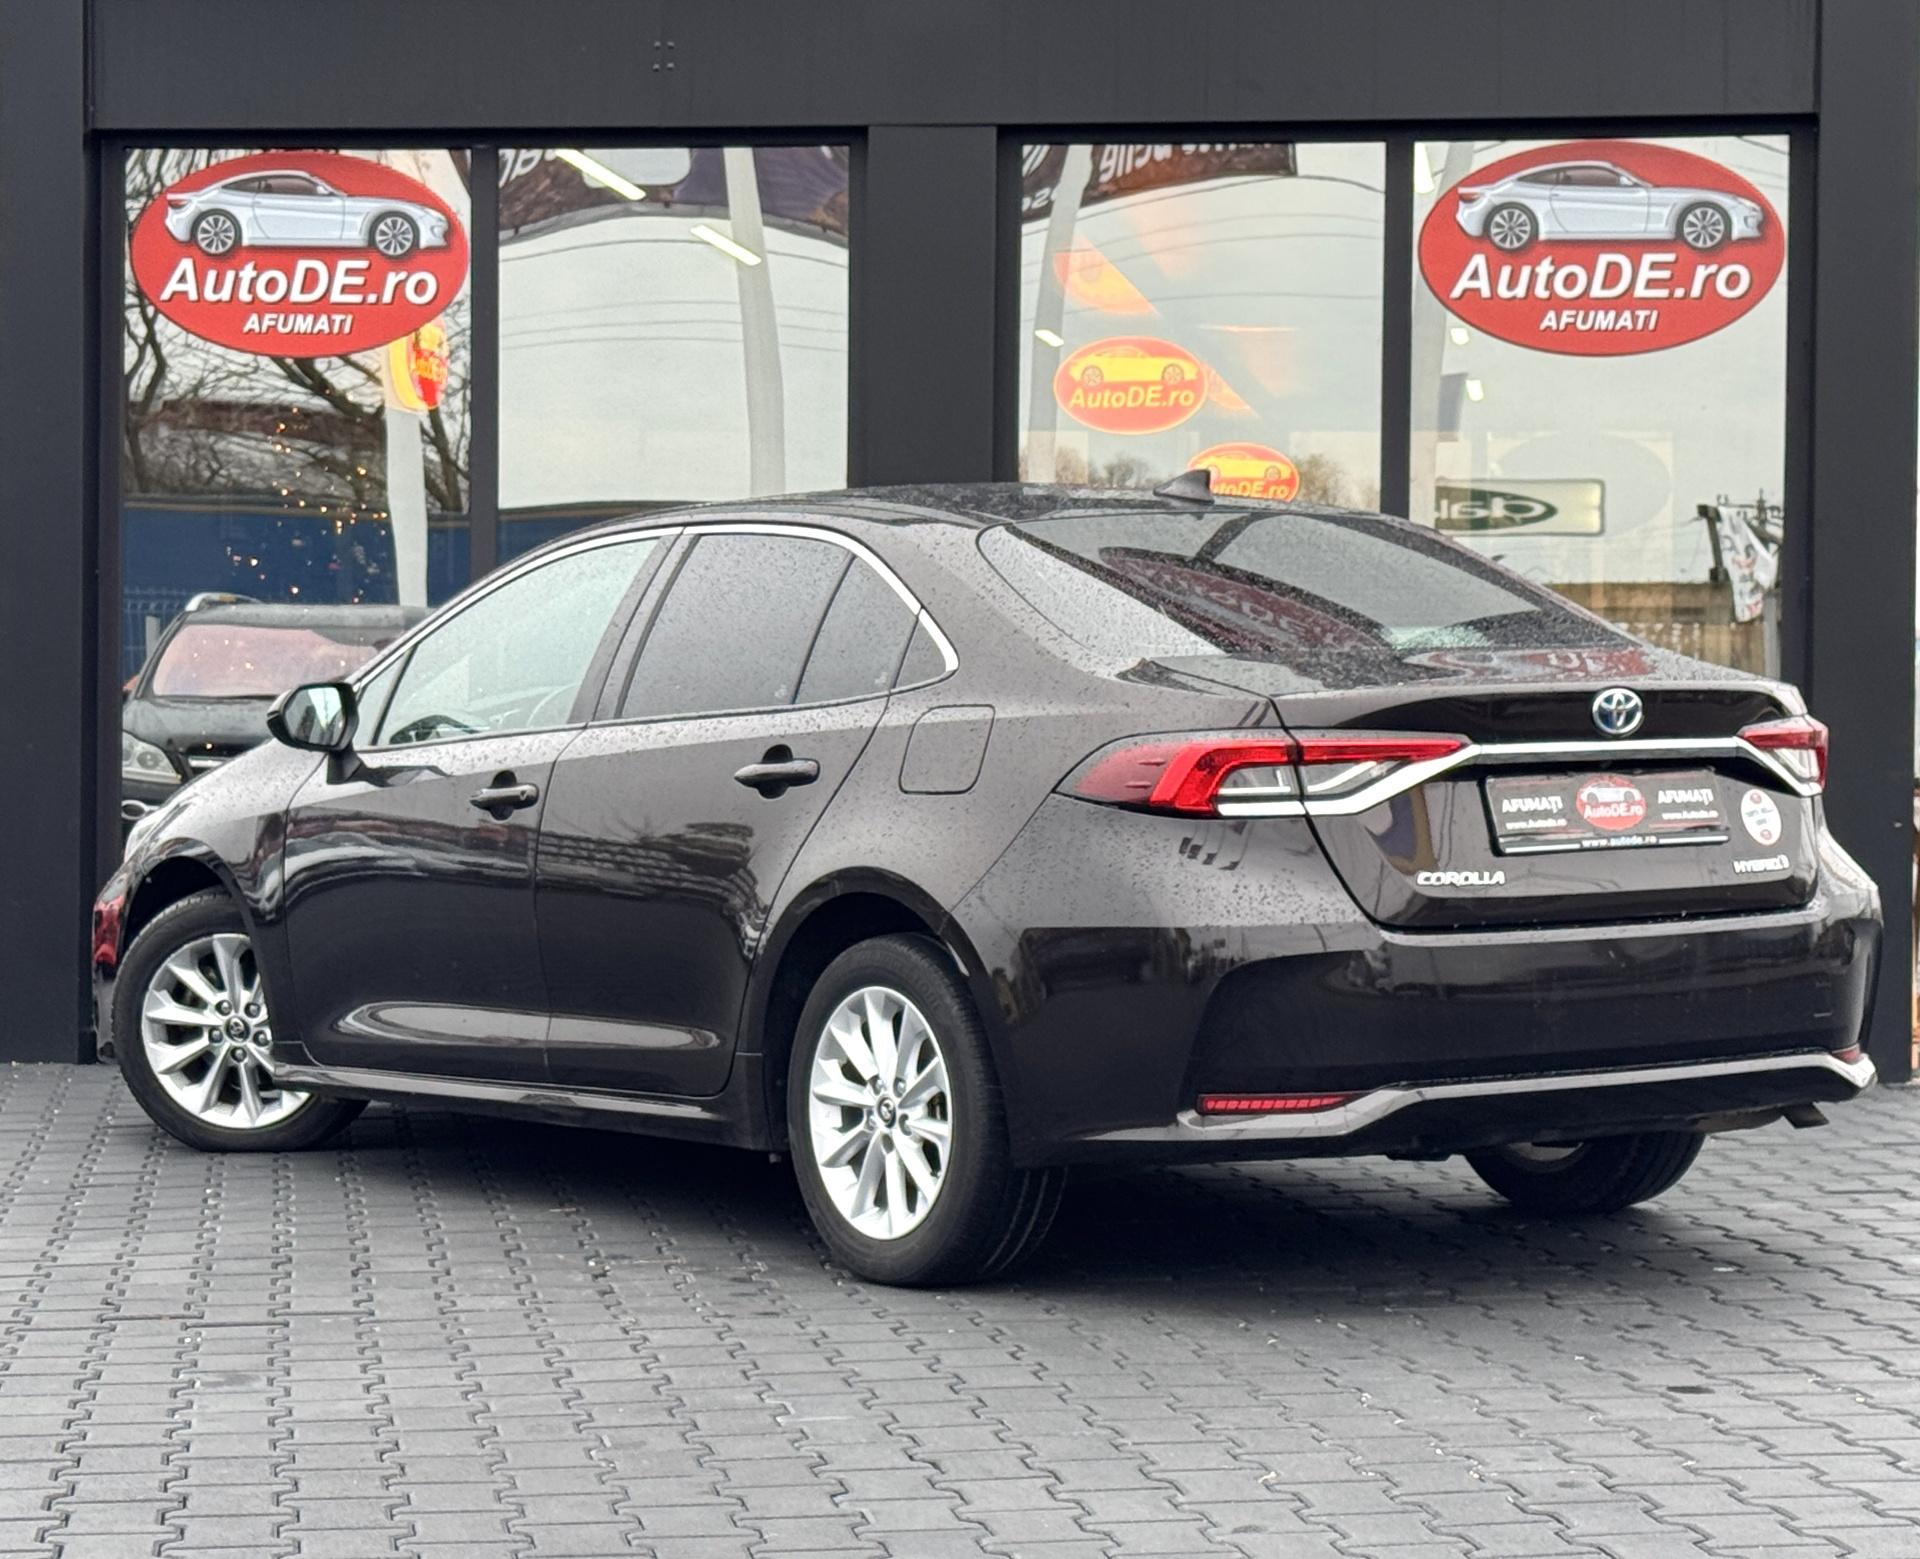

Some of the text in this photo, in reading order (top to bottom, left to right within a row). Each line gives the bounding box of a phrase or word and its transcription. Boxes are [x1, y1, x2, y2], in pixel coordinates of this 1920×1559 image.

[160, 257, 439, 306] AutoDE.ro
[1449, 252, 1752, 300] AutoDE.ro
[242, 312, 354, 335] AFUMATI
[1538, 309, 1660, 332] AFUMATI
[1068, 384, 1196, 410] AutoDE.ro
[1583, 801, 1644, 819] AutoDE.ro
[1416, 871, 1506, 887] COROLLA
